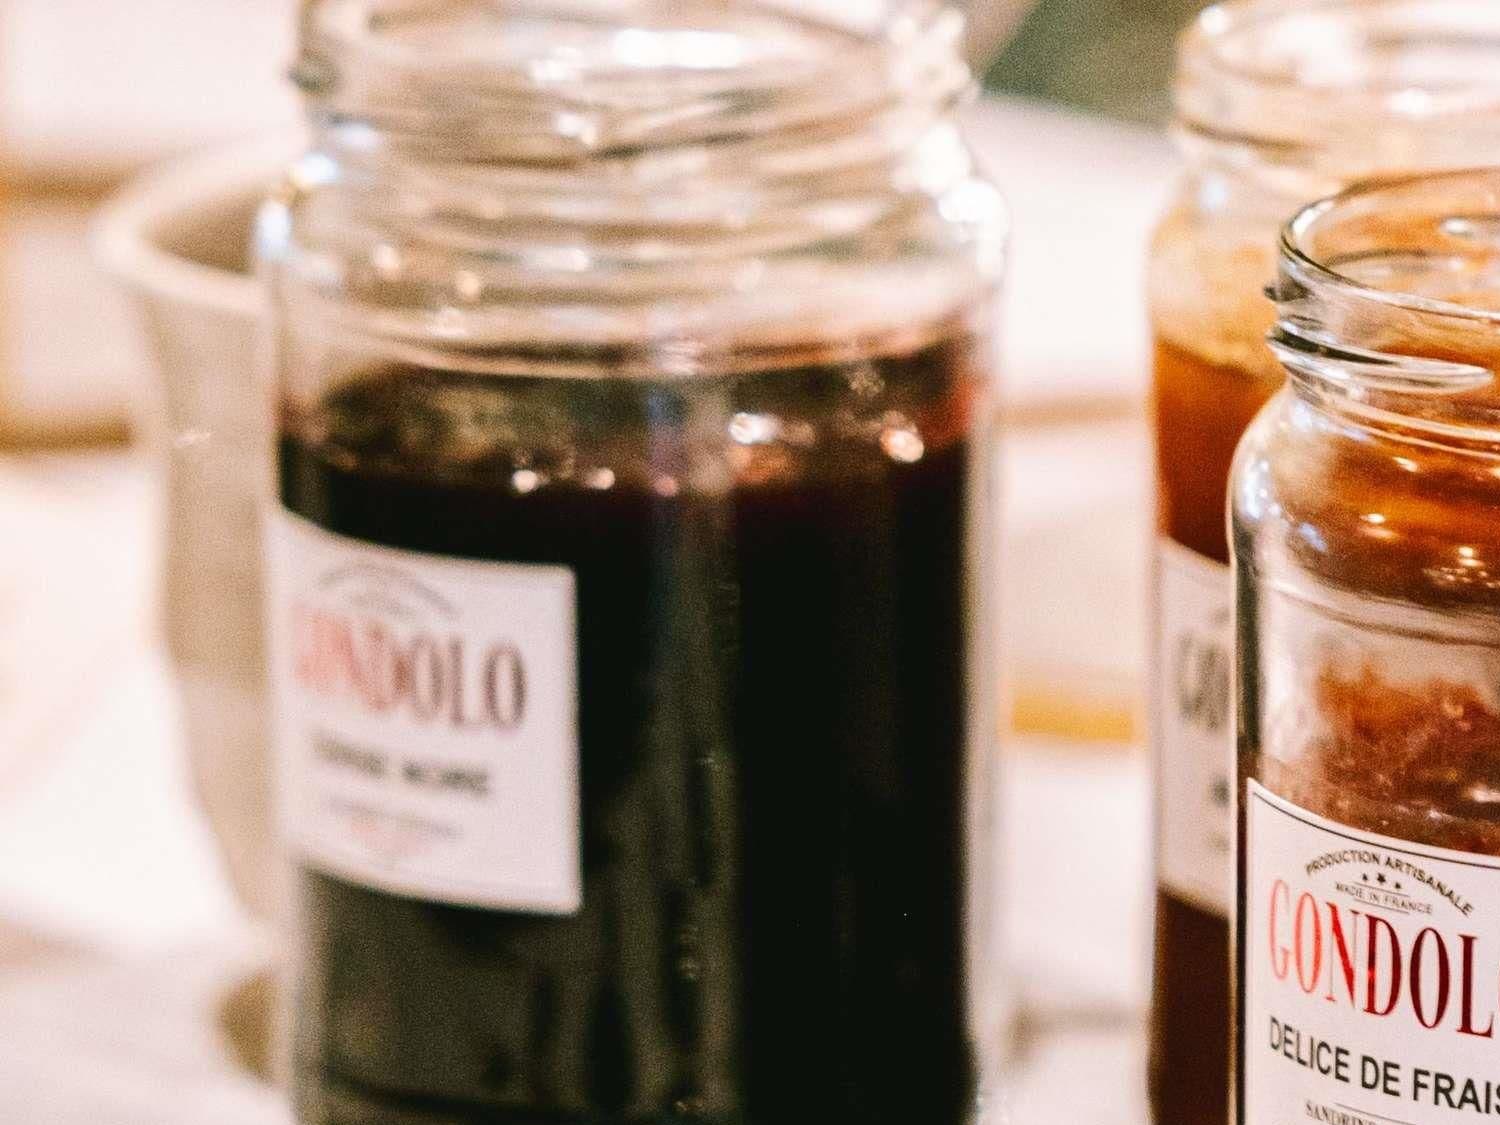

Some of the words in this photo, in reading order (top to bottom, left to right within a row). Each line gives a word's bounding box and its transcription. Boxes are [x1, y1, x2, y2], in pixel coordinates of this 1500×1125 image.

[293, 604, 528, 732] NDOLO
[1305, 850, 1380, 876] PRODUCTION
[1385, 857, 1474, 918] ARTISANALE
[1335, 881, 1363, 899] MADE
[1384, 895, 1432, 914] FRANCE
[1269, 1015, 1350, 1083] DELICE
[1360, 1055, 1401, 1098] DE
